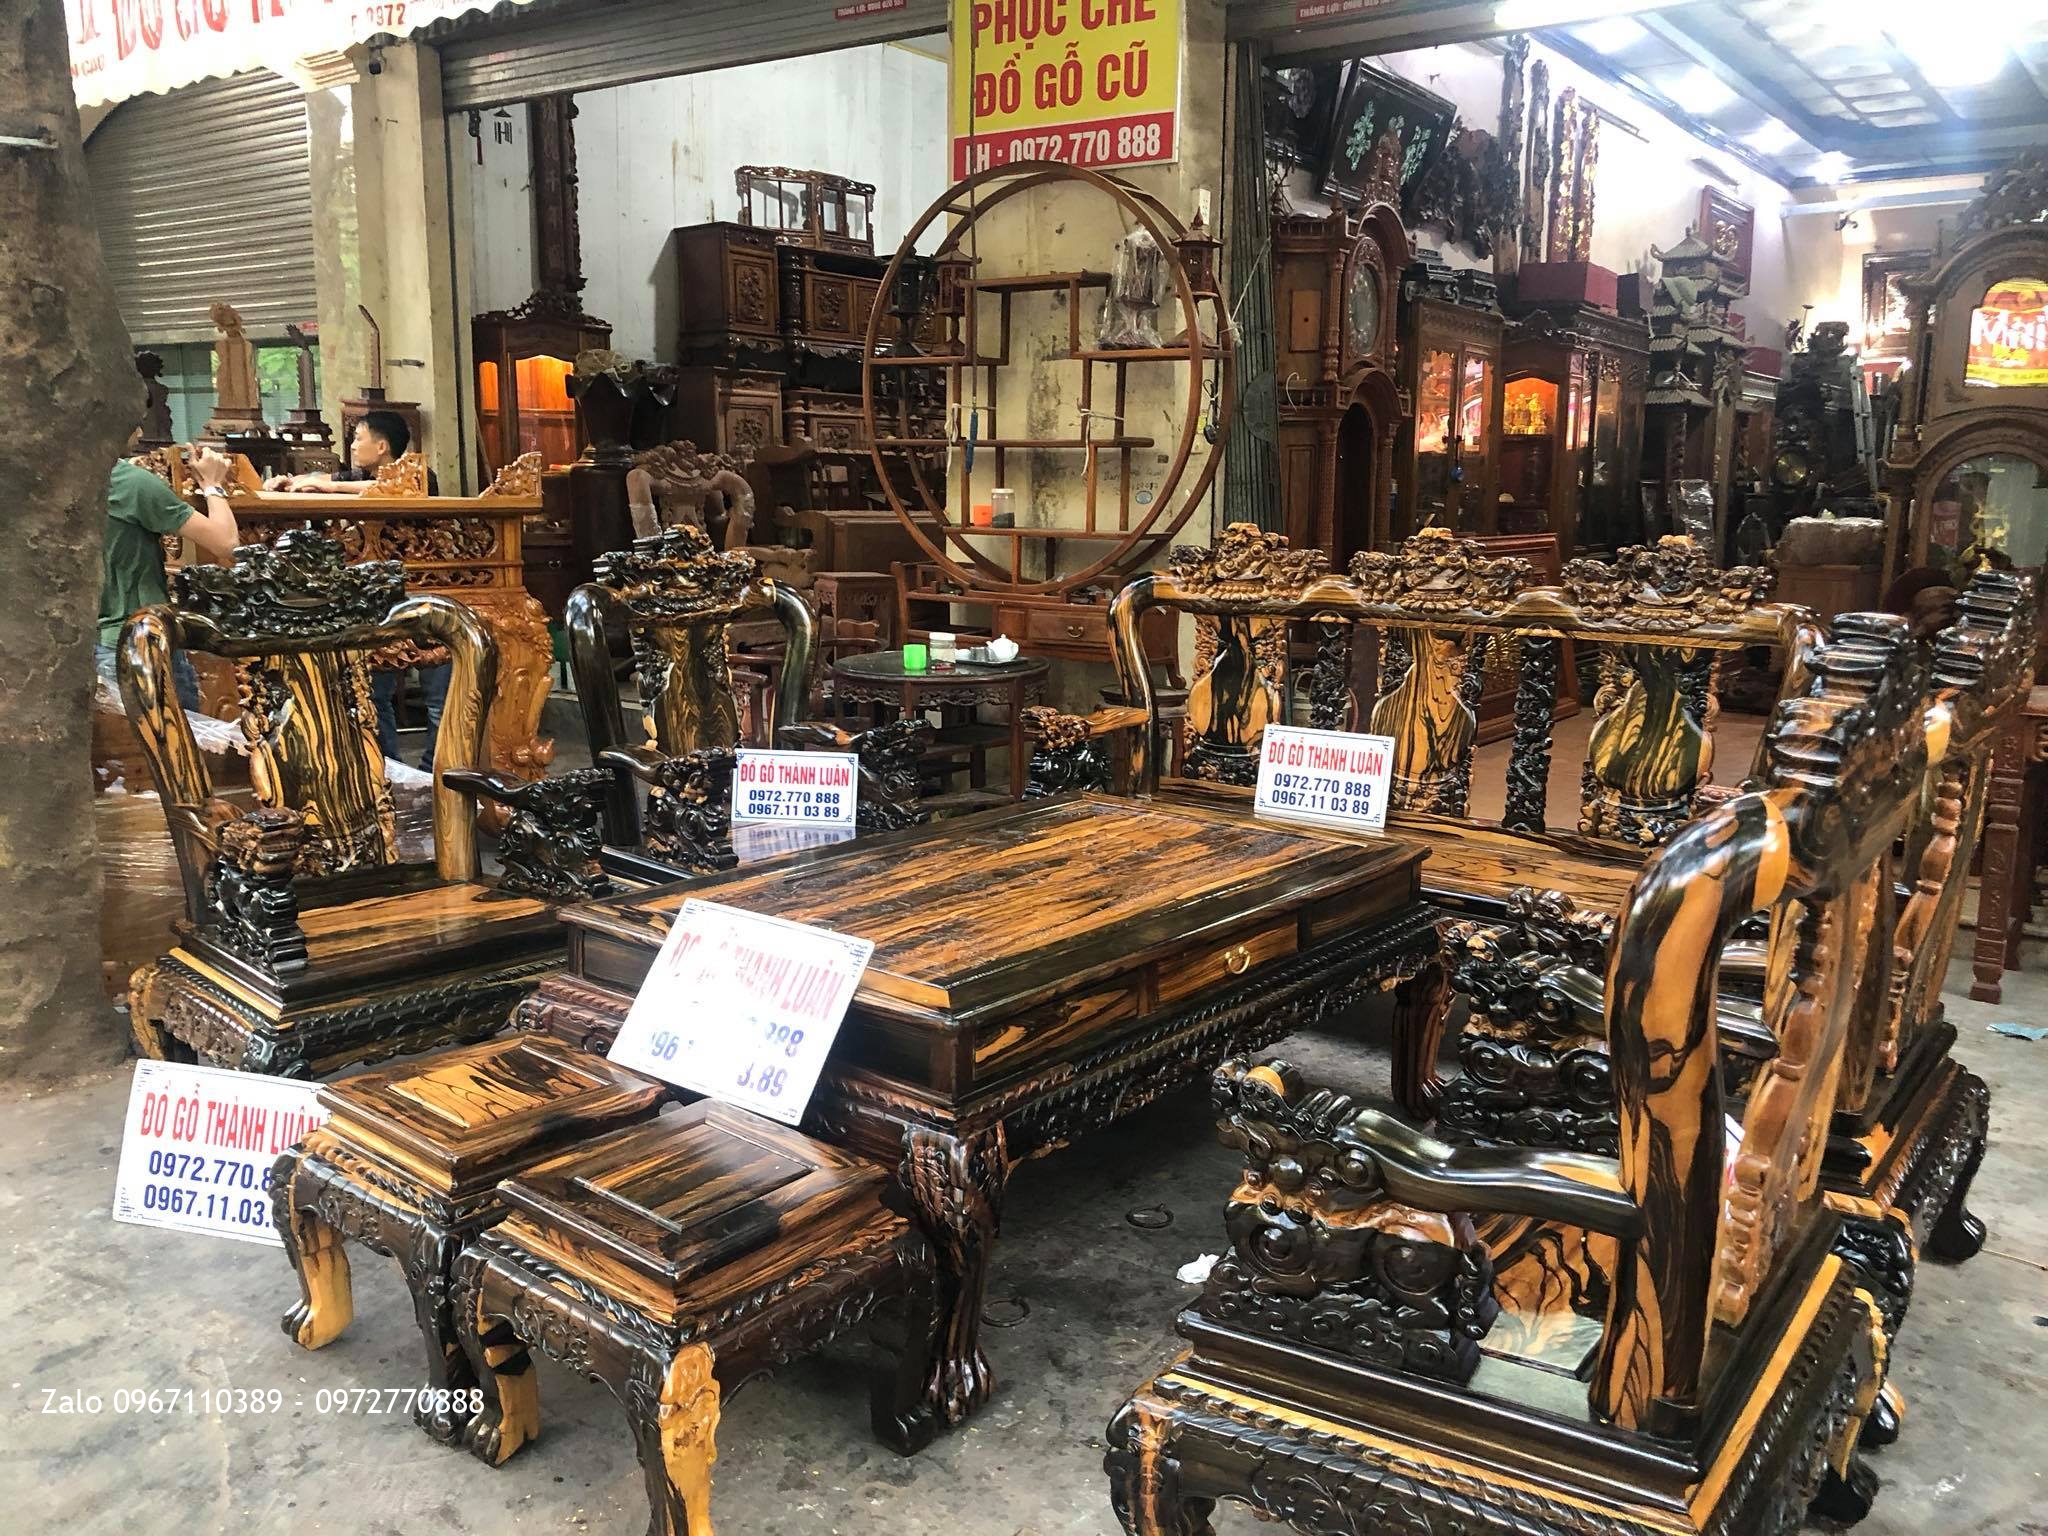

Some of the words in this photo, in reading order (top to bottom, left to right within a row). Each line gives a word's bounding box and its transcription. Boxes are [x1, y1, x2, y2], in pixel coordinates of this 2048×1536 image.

[974, 52, 1021, 118] ĐỒ
[1034, 41, 1083, 110] GỖ
[1097, 40, 1149, 101] CŨ
[1117, 123, 1161, 159] 888
[740, 758, 756, 782] ĐỒ
[820, 764, 850, 787] LUÂN
[1268, 736, 1286, 765] ĐỒ
[1288, 737, 1304, 767] GỖ
[1349, 748, 1383, 777] LUÂN
[815, 792, 840, 804] 888
[1344, 781, 1371, 798] 888
[140, 1079, 172, 1136] ĐỒ
[172, 1083, 201, 1142] GỖ
[205, 1095, 267, 1153] THÀNH
[270, 1105, 321, 1155] LUÂ
[148, 1150, 273, 1192] 0972.770.8
